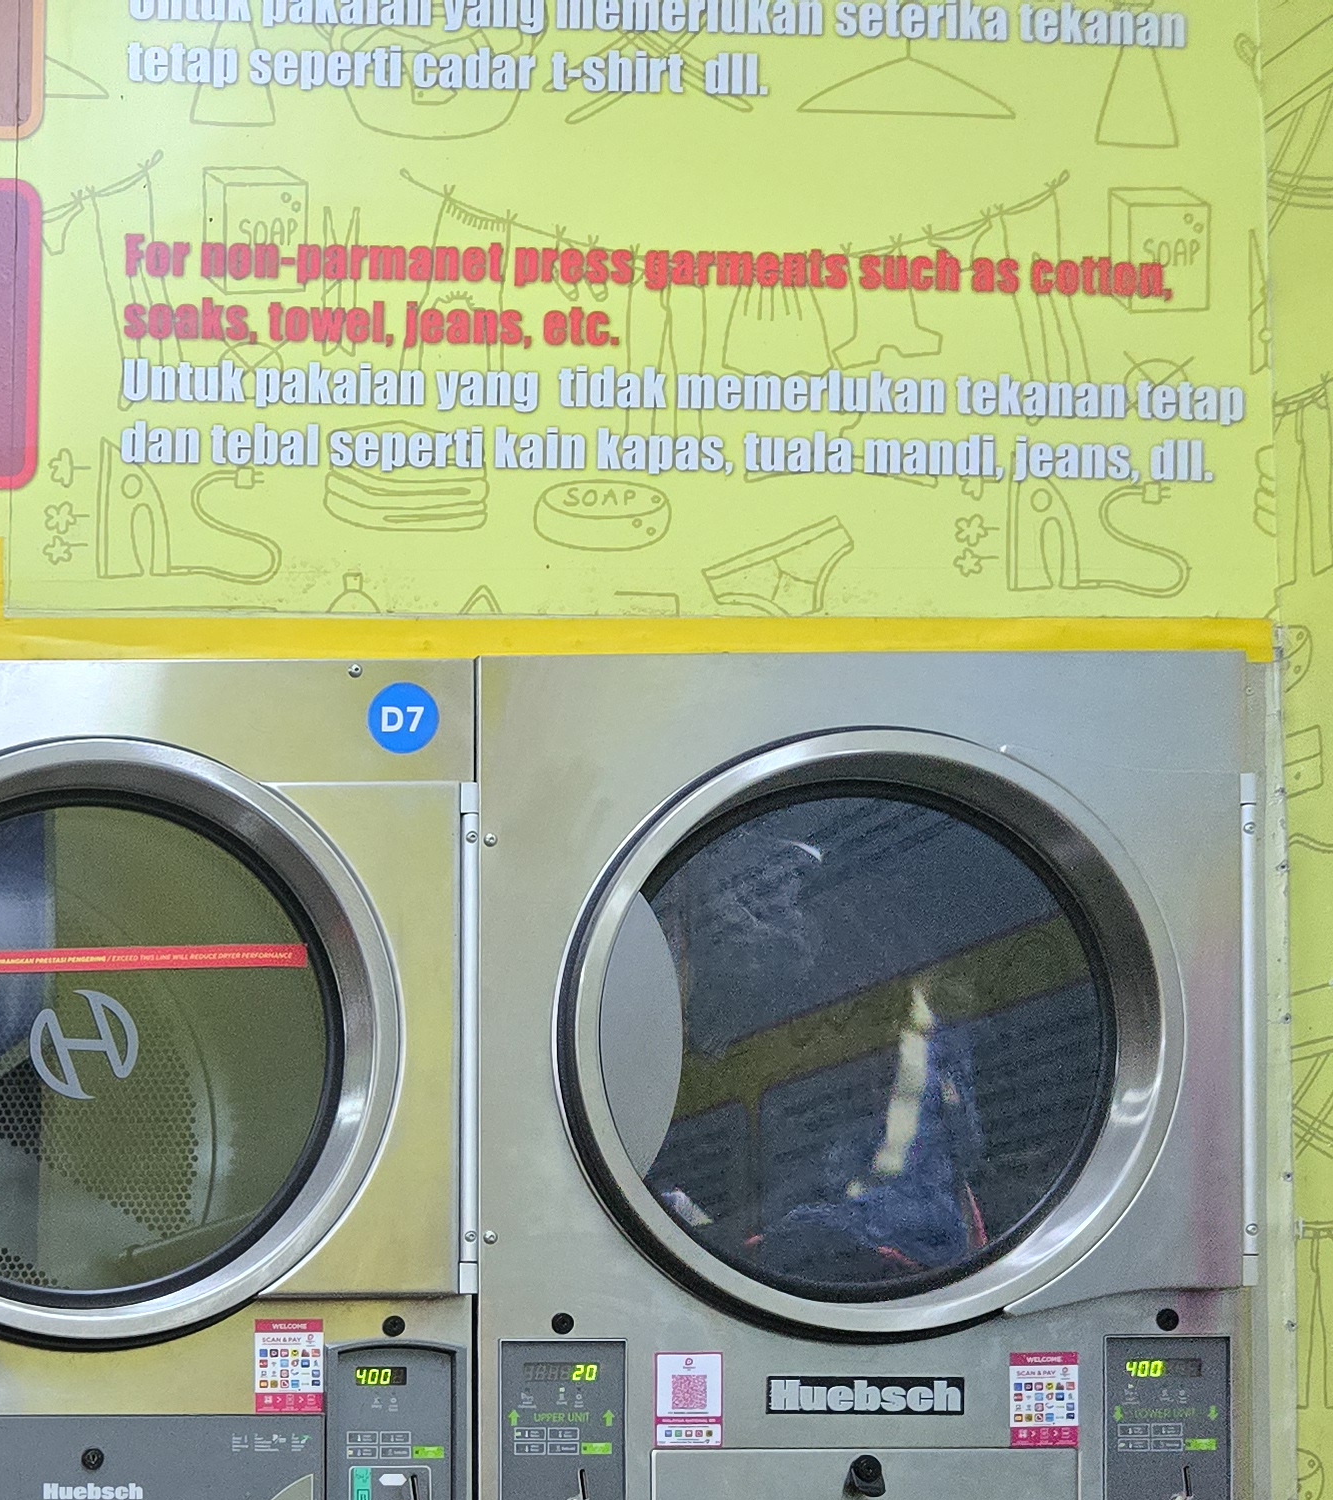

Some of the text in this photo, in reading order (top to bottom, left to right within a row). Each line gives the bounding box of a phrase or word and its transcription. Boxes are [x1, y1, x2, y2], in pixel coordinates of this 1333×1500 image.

[444, 0, 544, 34] yang
[556, 0, 822, 36] memerlukan
[835, 0, 1010, 41] seterika
[1020, 0, 1186, 48] tekanan
[128, 43, 768, 95] tetap seperti cadar t-shirt dll.
[124, 233, 1172, 300] For non-parmanet press garments such as cotton,
[268, 301, 394, 347] towel,
[405, 302, 532, 349] jeans,
[543, 306, 620, 346] etc.
[122, 358, 1245, 425] Untuk pakaian yang tidak memerlukan tekanan tetap
[121, 421, 1213, 482] dan tebal seperti kain kapas, tuala mandi, jeans, dll.
[563, 488, 636, 506] SOAP
[381, 706, 424, 732] D7
[272, 1322, 308, 1330] WELCOME
[356, 1369, 391, 1385] 400
[572, 1364, 597, 1381] 20
[1126, 1360, 1163, 1377] 400
[770, 1379, 962, 1412] Huebsch
[533, 1411, 590, 1423] UPPER UNIT
[43, 1483, 143, 1500] Huebsch
